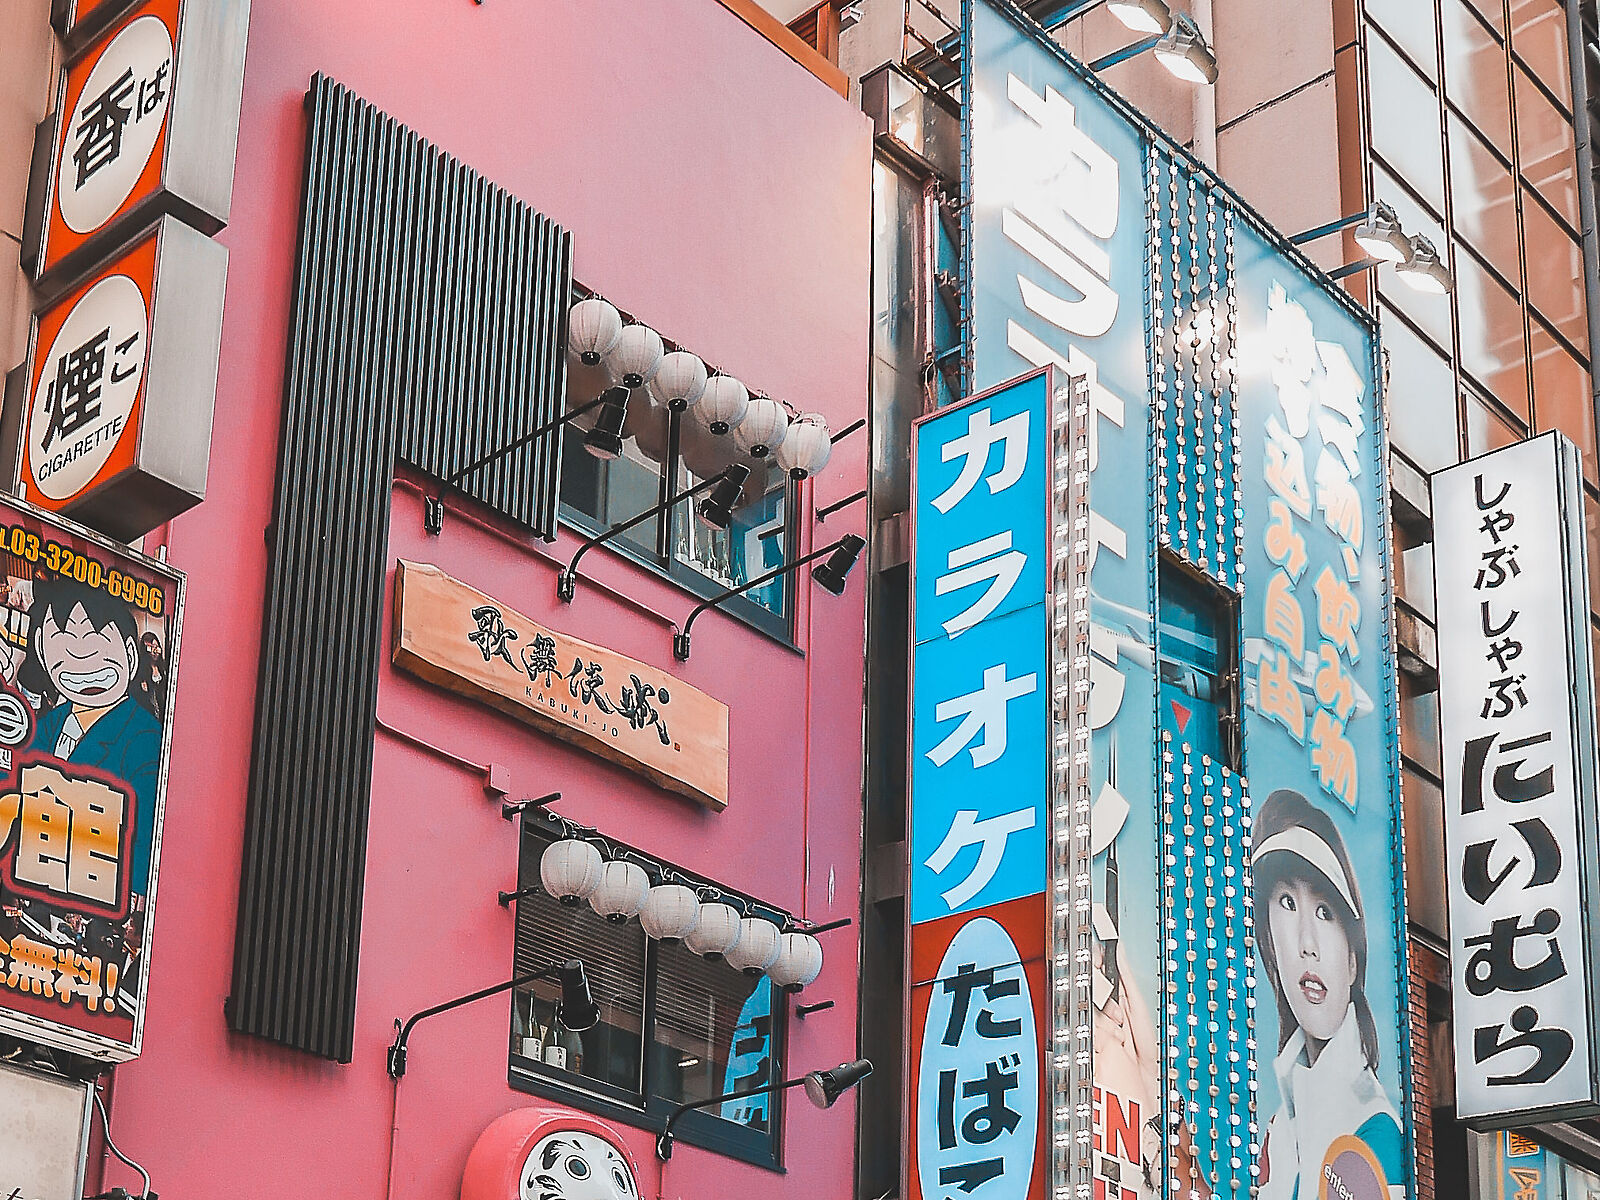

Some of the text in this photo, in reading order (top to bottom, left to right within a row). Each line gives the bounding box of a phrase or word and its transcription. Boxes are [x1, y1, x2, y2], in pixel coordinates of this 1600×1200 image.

[73, 66, 133, 192] 香
[136, 58, 170, 125] ば
[42, 326, 110, 453] 煙
[110, 331, 140, 384] こ
[38, 413, 123, 482] CIGARETTE
[925, 407, 1037, 911] カラオケ
[1473, 473, 1528, 720] しゃぶしゃぶ
[524, 685, 620, 738] KABUKI-JO
[1461, 732, 1574, 1087] にいむら
